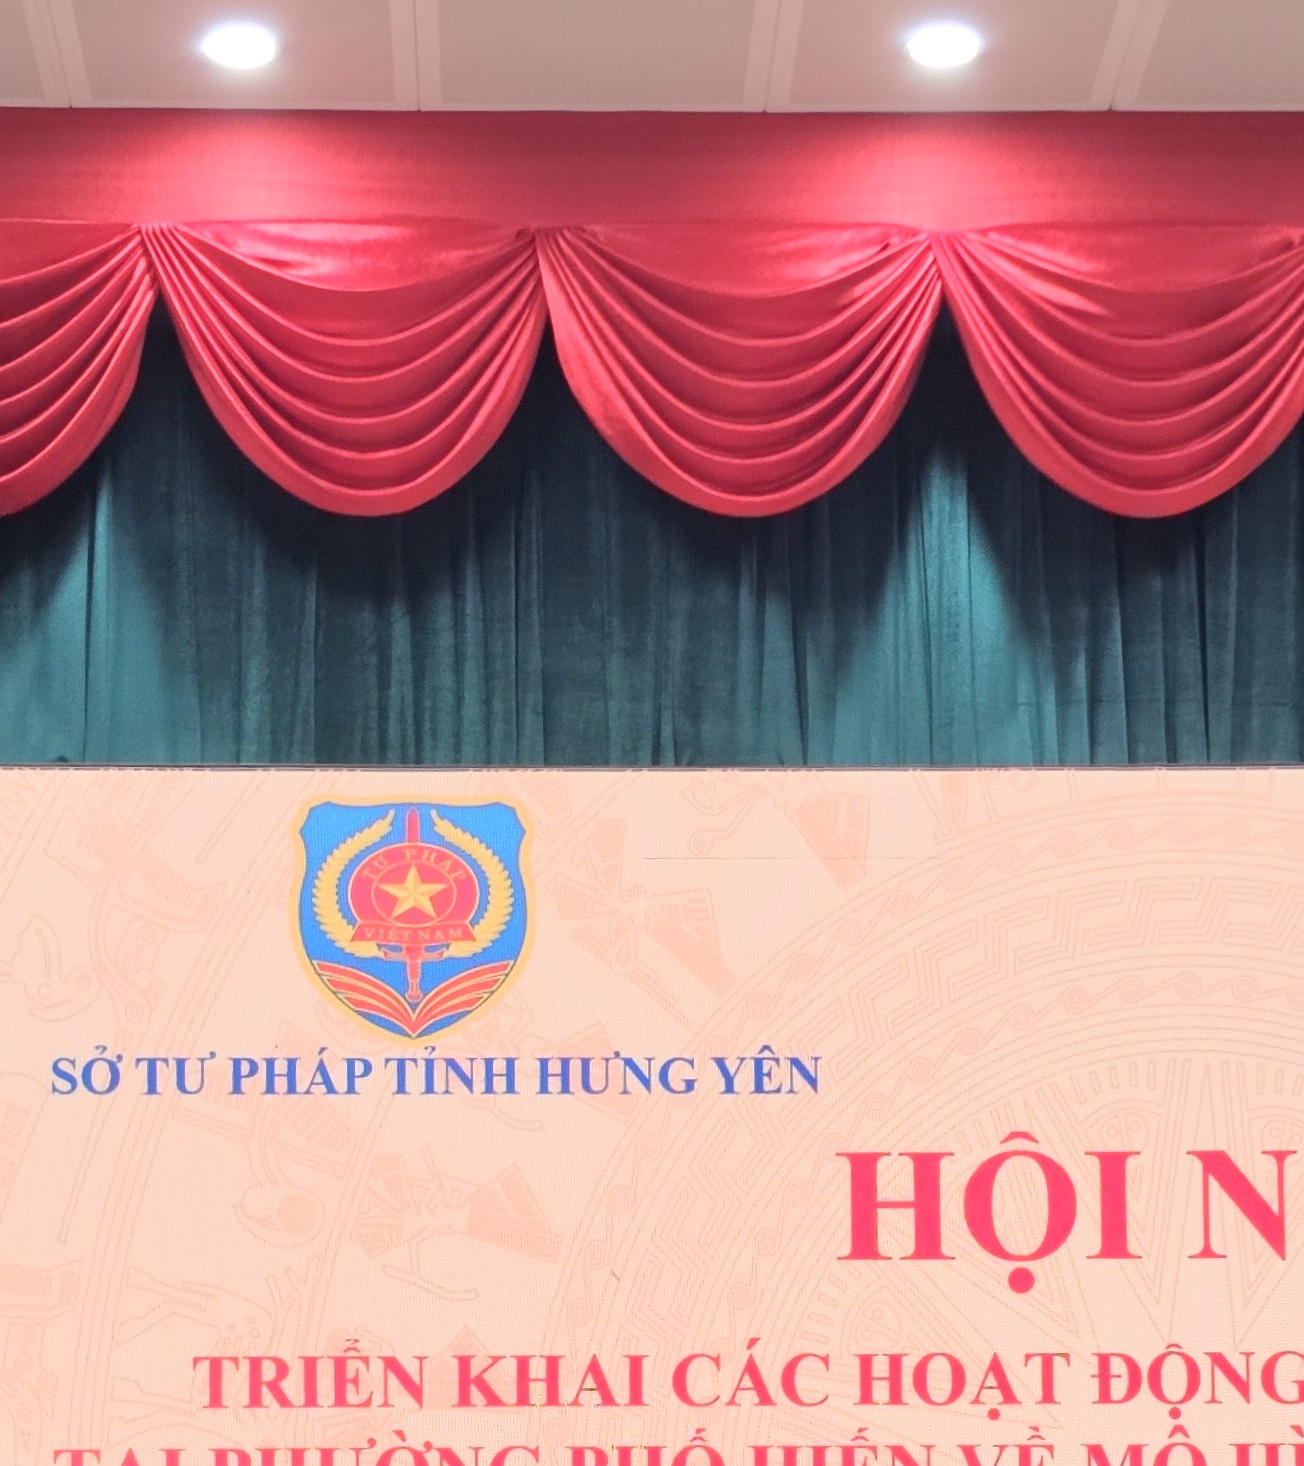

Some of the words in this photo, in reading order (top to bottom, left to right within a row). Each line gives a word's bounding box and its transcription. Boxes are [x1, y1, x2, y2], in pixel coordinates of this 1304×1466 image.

[417, 927, 464, 941] NAM
[49, 1045, 125, 1096] SỞ
[133, 1052, 219, 1097] TƯ
[229, 1047, 376, 1097] PHÁP
[383, 1046, 520, 1096] TỈNH
[536, 1051, 698, 1096] HƯNG
[712, 1044, 821, 1096] YÊN
[836, 1130, 1143, 1295] HỘI
[191, 1339, 428, 1410] TRIỂN
[452, 1354, 649, 1409] KHAI
[670, 1336, 832, 1409] CÁC
[855, 1352, 1073, 1422] HOẠT
